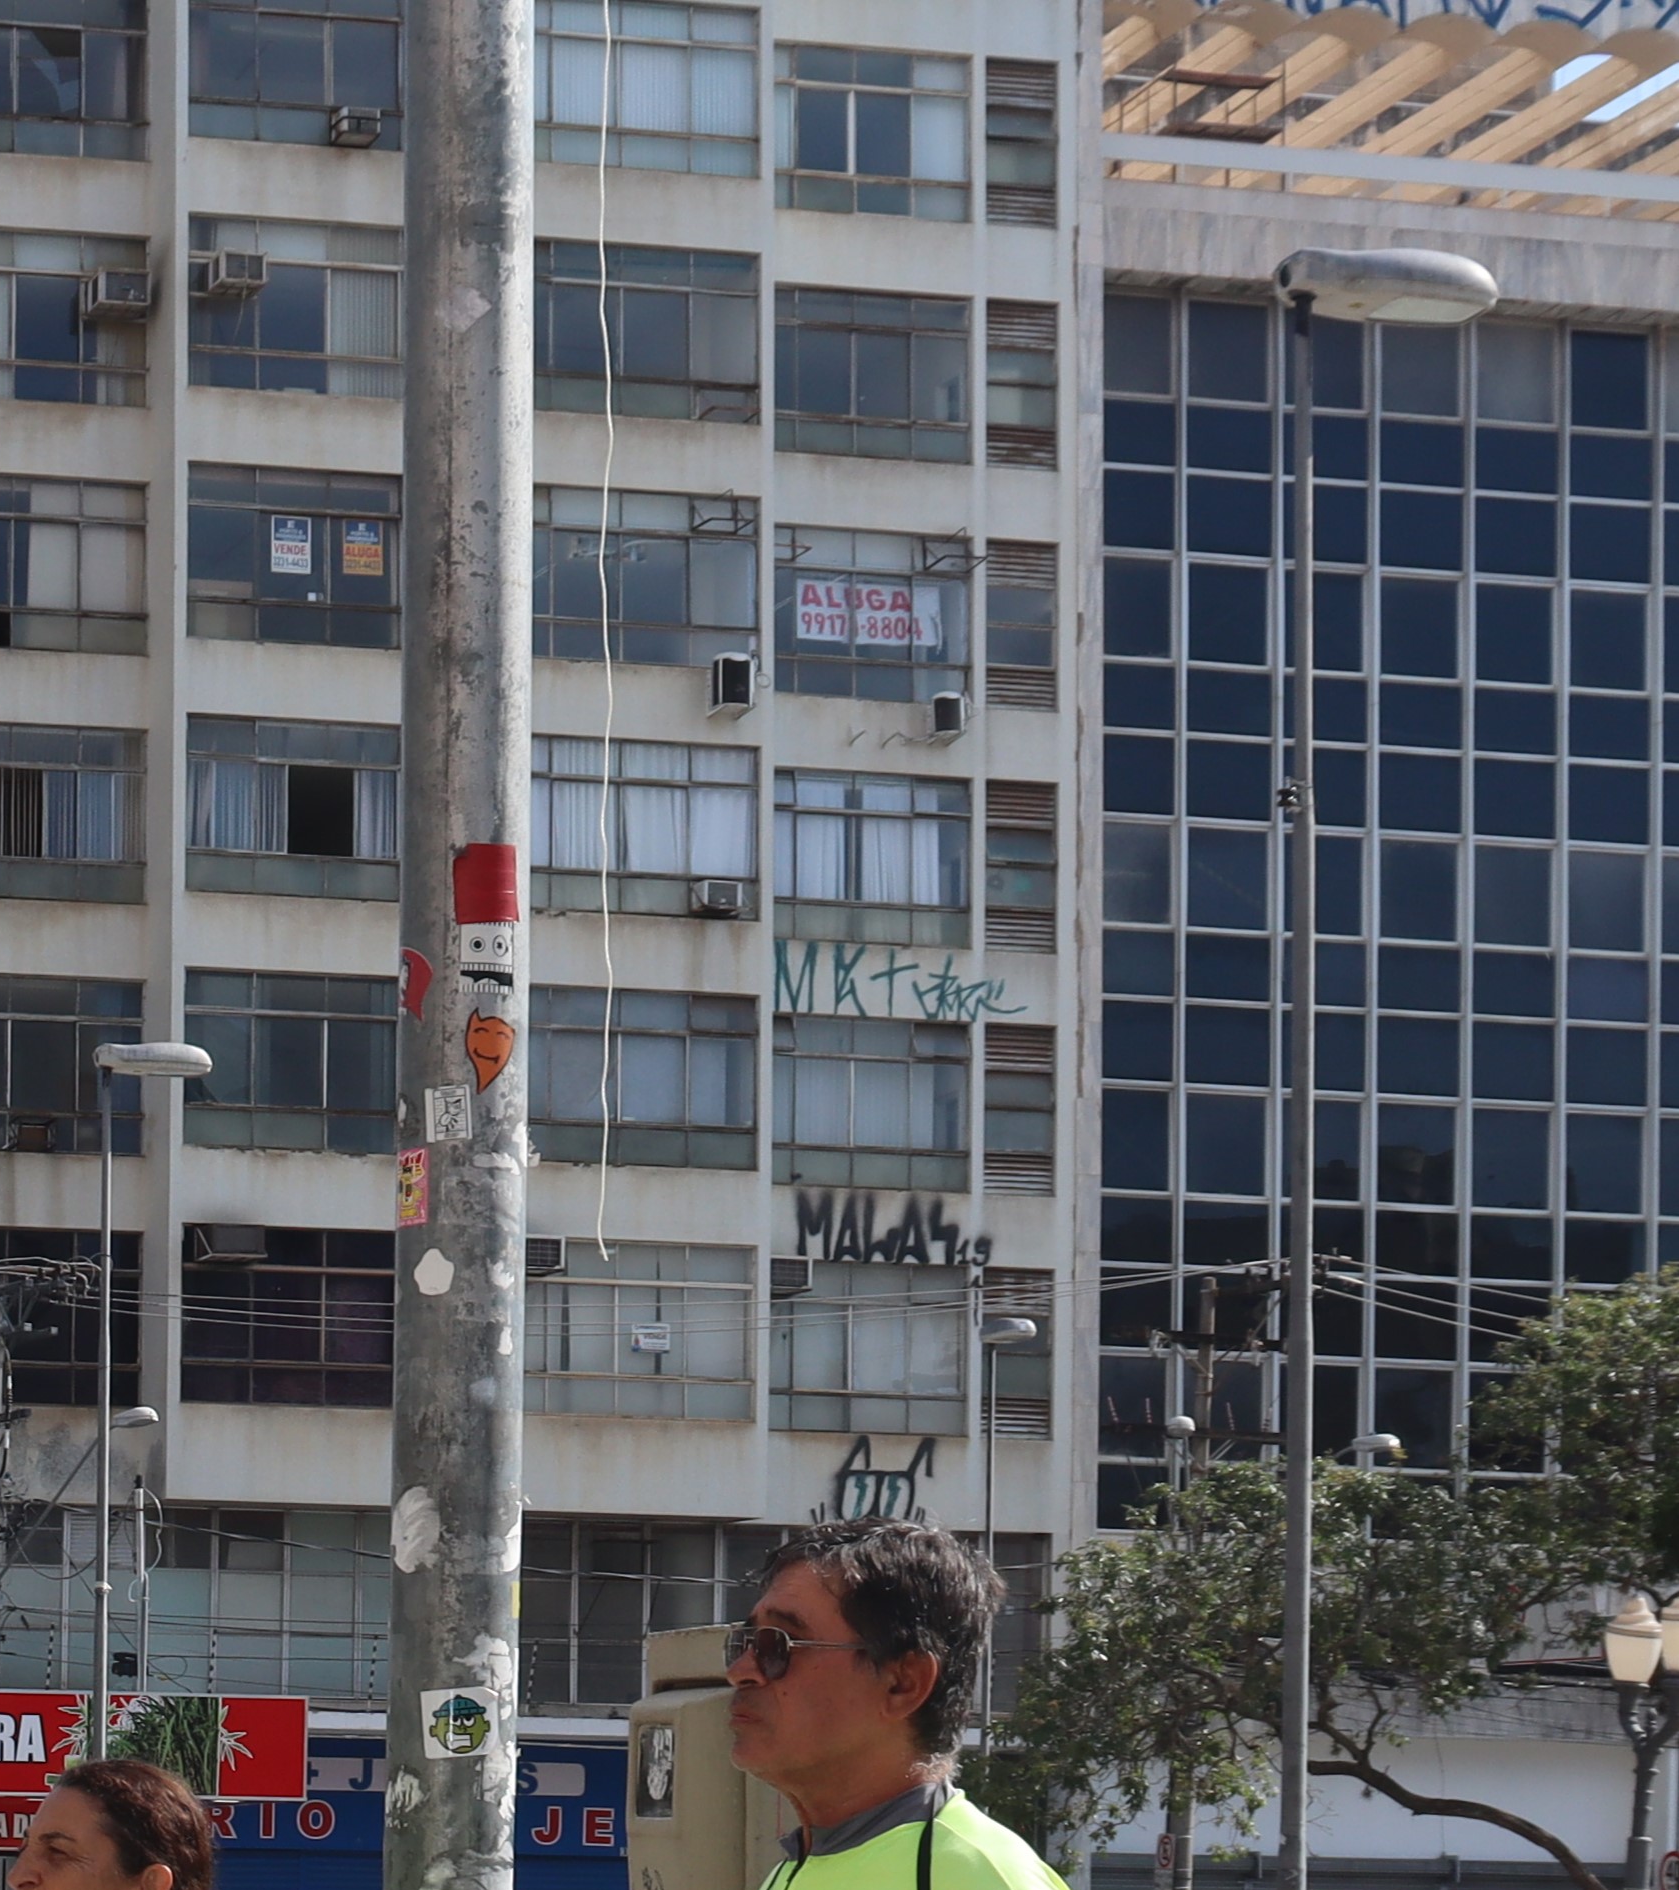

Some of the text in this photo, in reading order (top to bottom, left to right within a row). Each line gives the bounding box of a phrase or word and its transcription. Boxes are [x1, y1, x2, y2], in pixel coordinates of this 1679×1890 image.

[273, 543, 307, 556] VENDE
[801, 583, 911, 613] ALUGA
[12, 1813, 35, 1839] D
